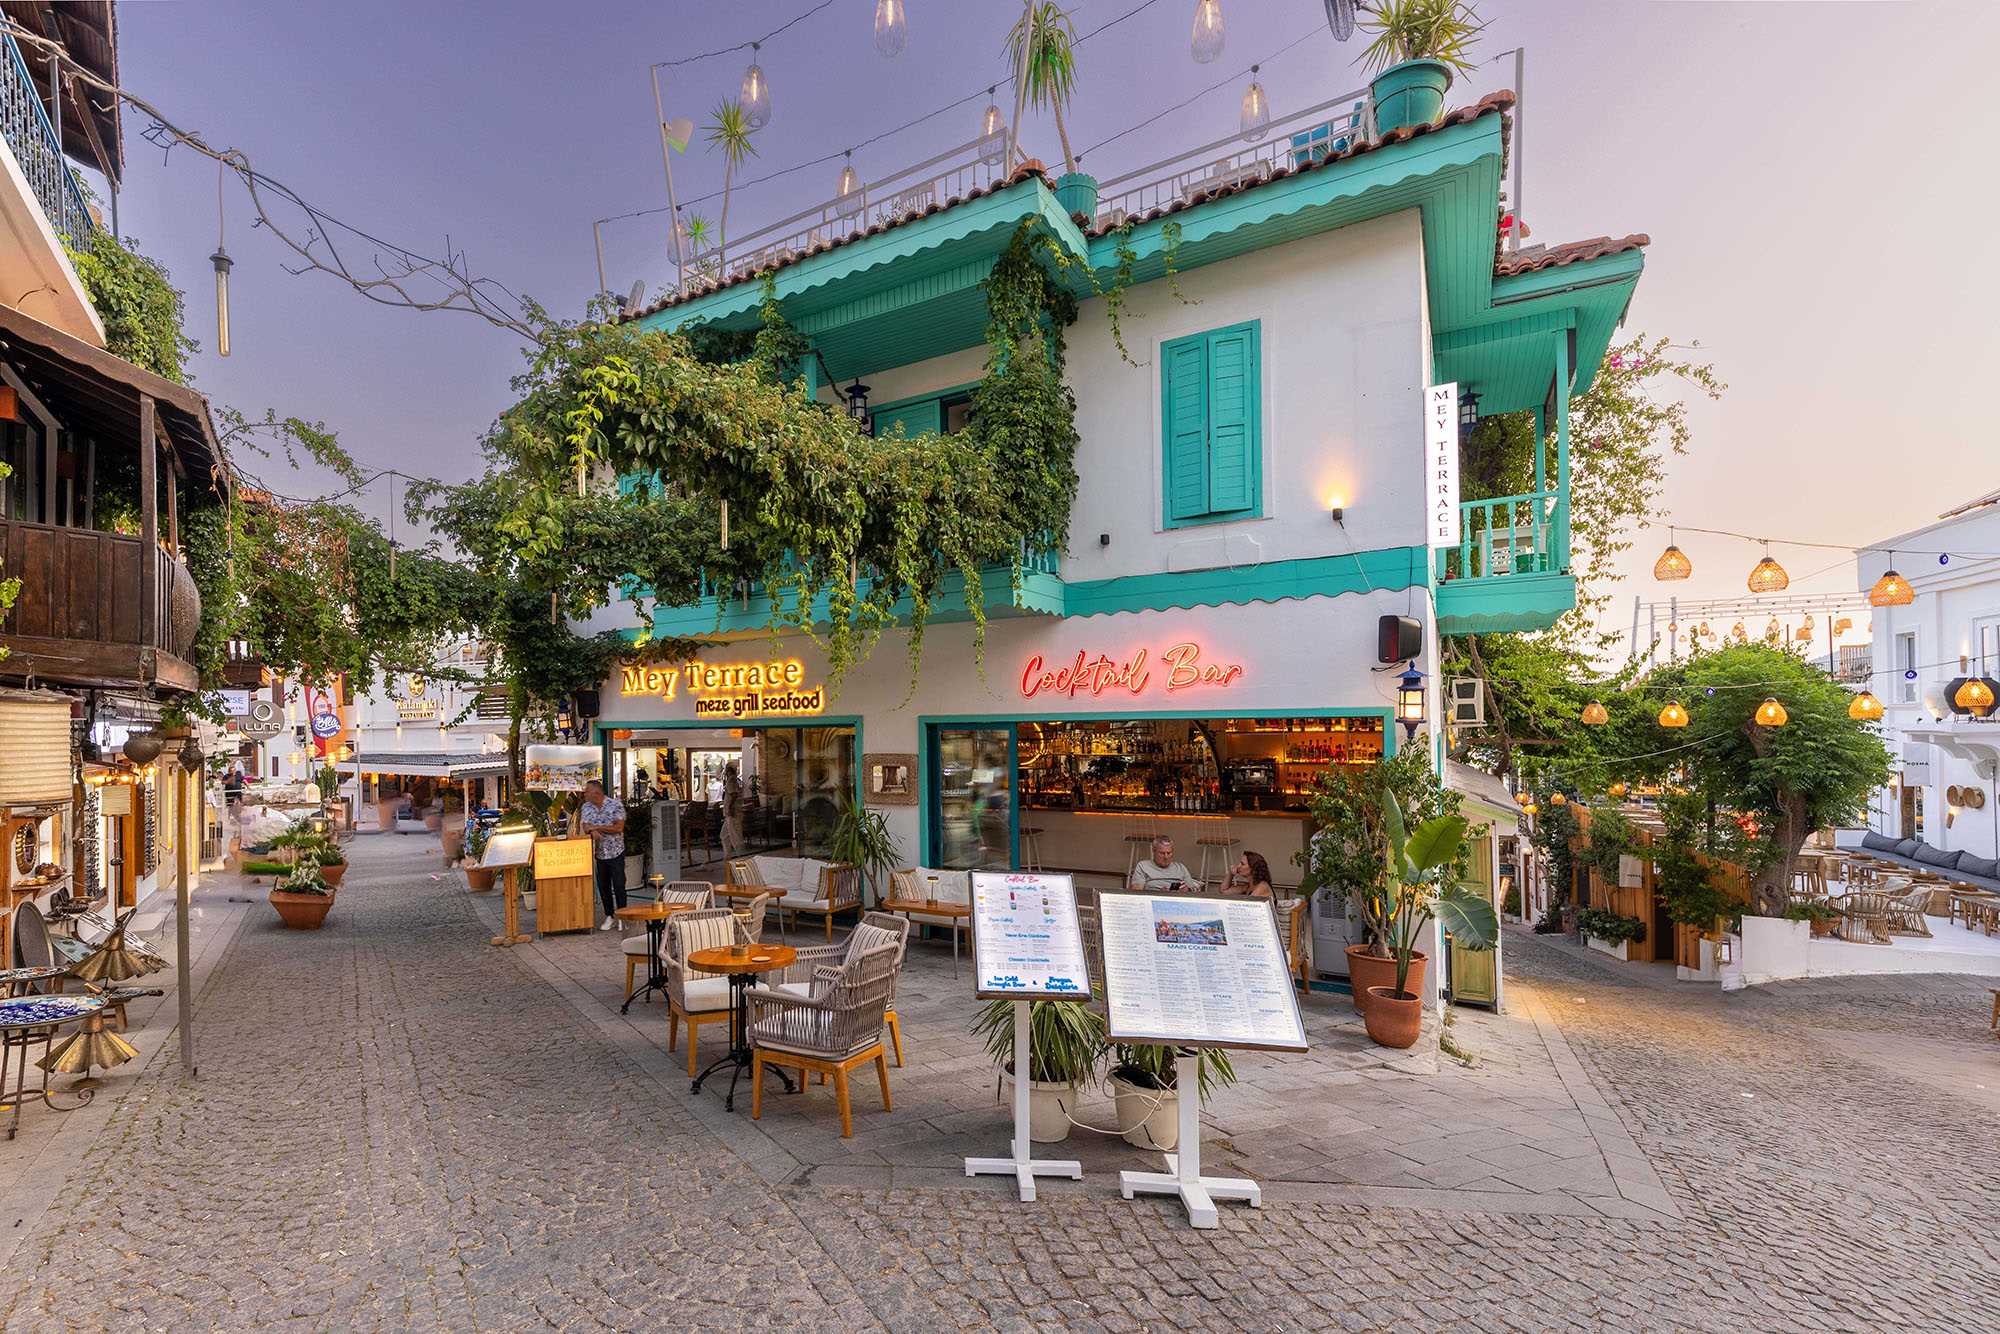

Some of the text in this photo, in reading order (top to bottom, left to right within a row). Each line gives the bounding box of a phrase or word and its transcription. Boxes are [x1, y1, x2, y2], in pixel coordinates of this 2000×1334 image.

[1434, 390, 1449, 537] MEY TERRACE
[620, 663, 800, 697] Mey Terrace
[1021, 643, 1242, 698] Cocktail Bar
[695, 689, 820, 716] meze grill seafood
